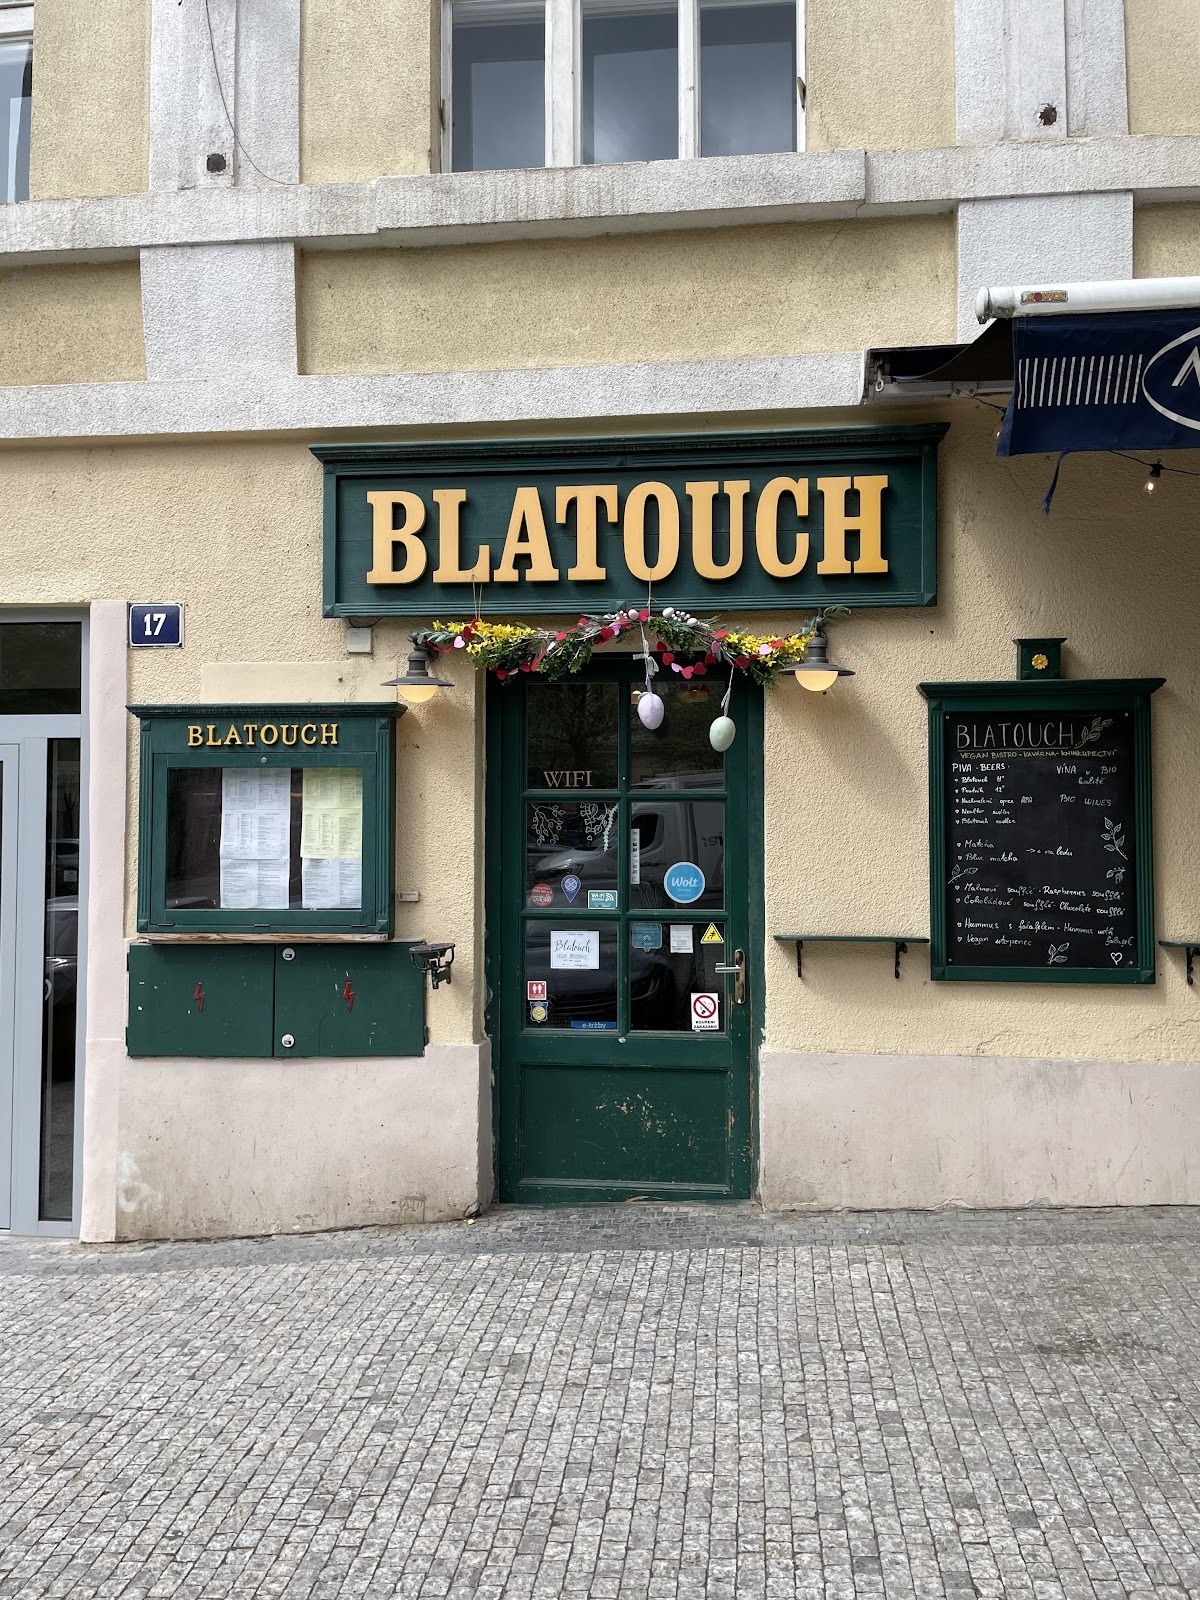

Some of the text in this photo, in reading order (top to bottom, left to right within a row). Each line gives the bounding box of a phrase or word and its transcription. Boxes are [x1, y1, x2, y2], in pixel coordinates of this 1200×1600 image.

[365, 475, 889, 584] BLATOUCH
[143, 613, 167, 636] 17
[187, 723, 339, 747] BLATOUCH
[956, 721, 1074, 749] BLATOUCH
[959, 752, 989, 760] VEGAN
[991, 751, 1018, 759] BISTRO
[952, 762, 1006, 773] PIVA BEERS
[1056, 762, 1077, 775] VÍNA
[1100, 765, 1118, 775] BIO
[543, 770, 593, 788] WIFI
[1059, 793, 1112, 807] BIO WINES
[964, 838, 995, 849] Matcha
[989, 852, 1019, 862] matcha
[671, 876, 699, 888] Wolt
[966, 933, 989, 946] Vegan
[581, 1021, 607, 1030] e-tržby
